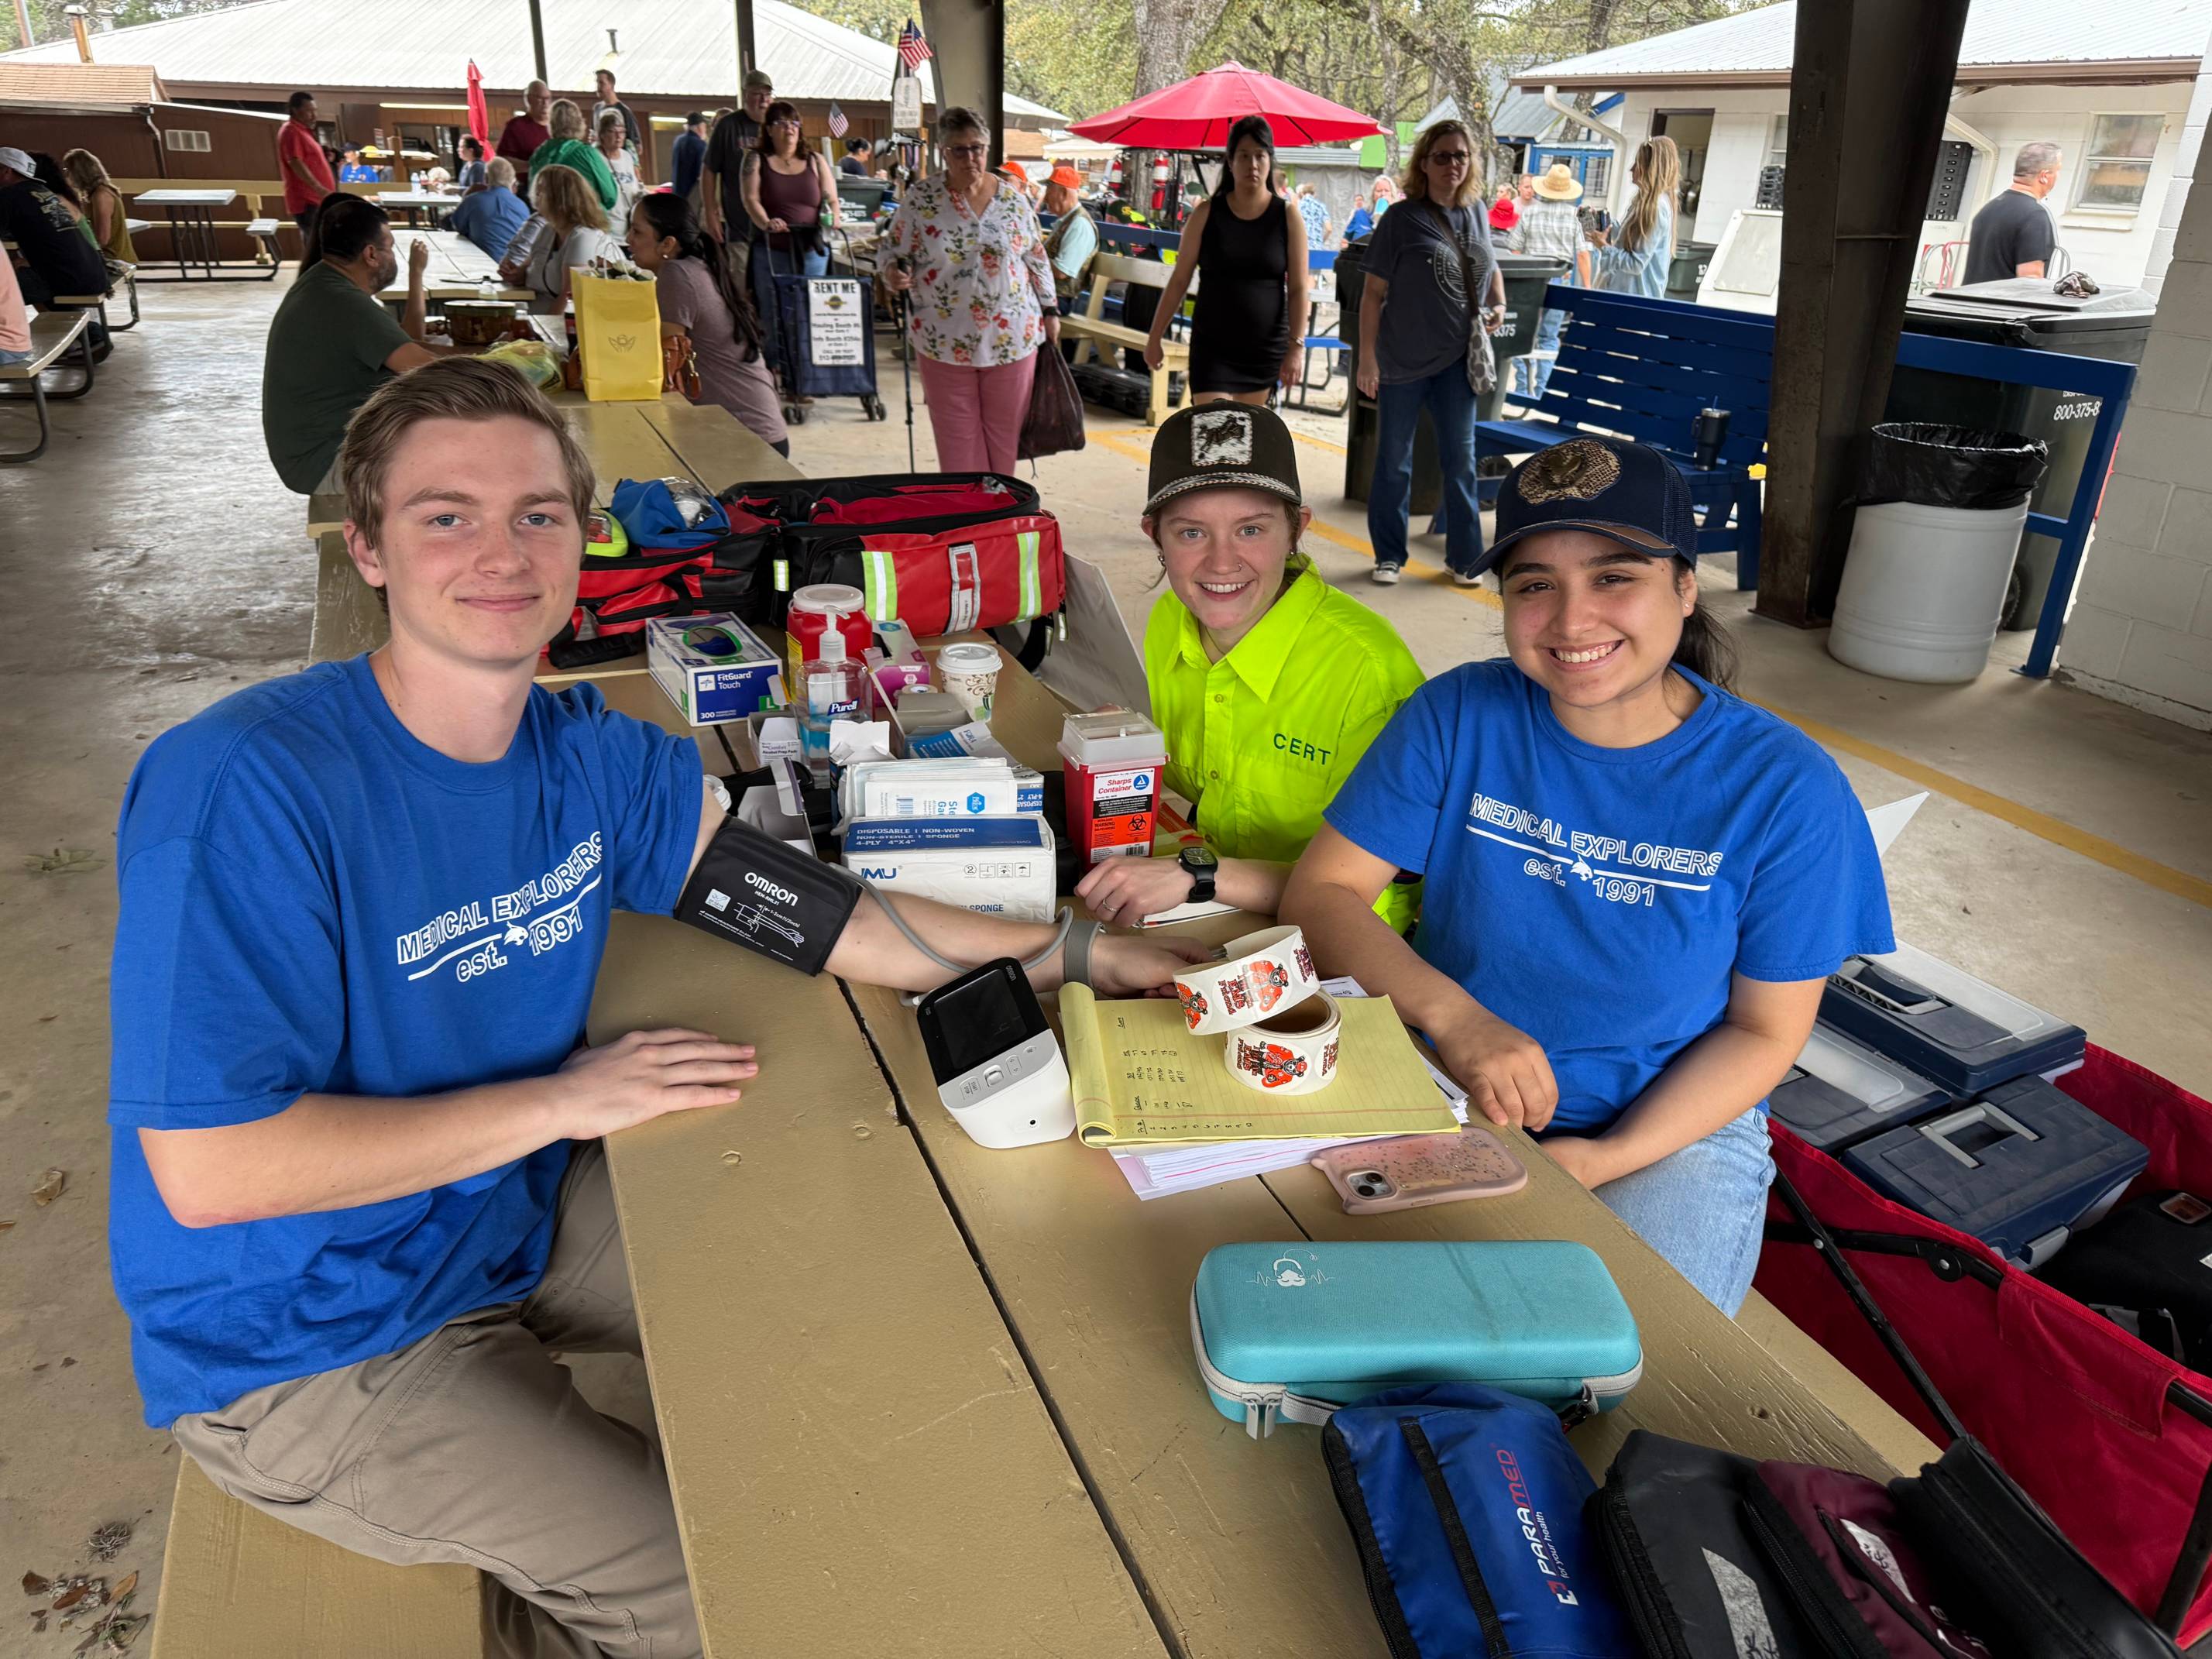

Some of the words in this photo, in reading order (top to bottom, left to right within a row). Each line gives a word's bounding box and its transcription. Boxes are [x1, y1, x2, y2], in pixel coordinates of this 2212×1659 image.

[842, 282, 856, 294] ME
[2053, 400, 2103, 421] 800-375-8
[717, 671, 751, 682] FitGuard
[718, 681, 741, 690] Touch
[766, 697, 775, 709] L
[830, 700, 858, 713] Purell
[1273, 733, 1331, 765] CERT
[1098, 785, 1132, 795] Container
[1107, 778, 1132, 786] Sharps
[1469, 792, 1568, 847] MEDICAL
[1570, 830, 1723, 877] EXPLORERS
[744, 872, 799, 907] OMRON
[1523, 858, 1566, 888] est.
[1592, 876, 1655, 907] 1991
[970, 904, 1004, 912] SPONGE
[397, 901, 489, 965] MEDICAL
[455, 940, 508, 983] est.
[528, 905, 583, 957] 1991
[1218, 979, 1237, 1015] Friend
[1228, 978, 1246, 1010] EMS
[1496, 1449, 1557, 1576] PARAMED
[1535, 1510, 1551, 1542] health
[1547, 1543, 1565, 1567] your
[1559, 1566, 1570, 1578] for
